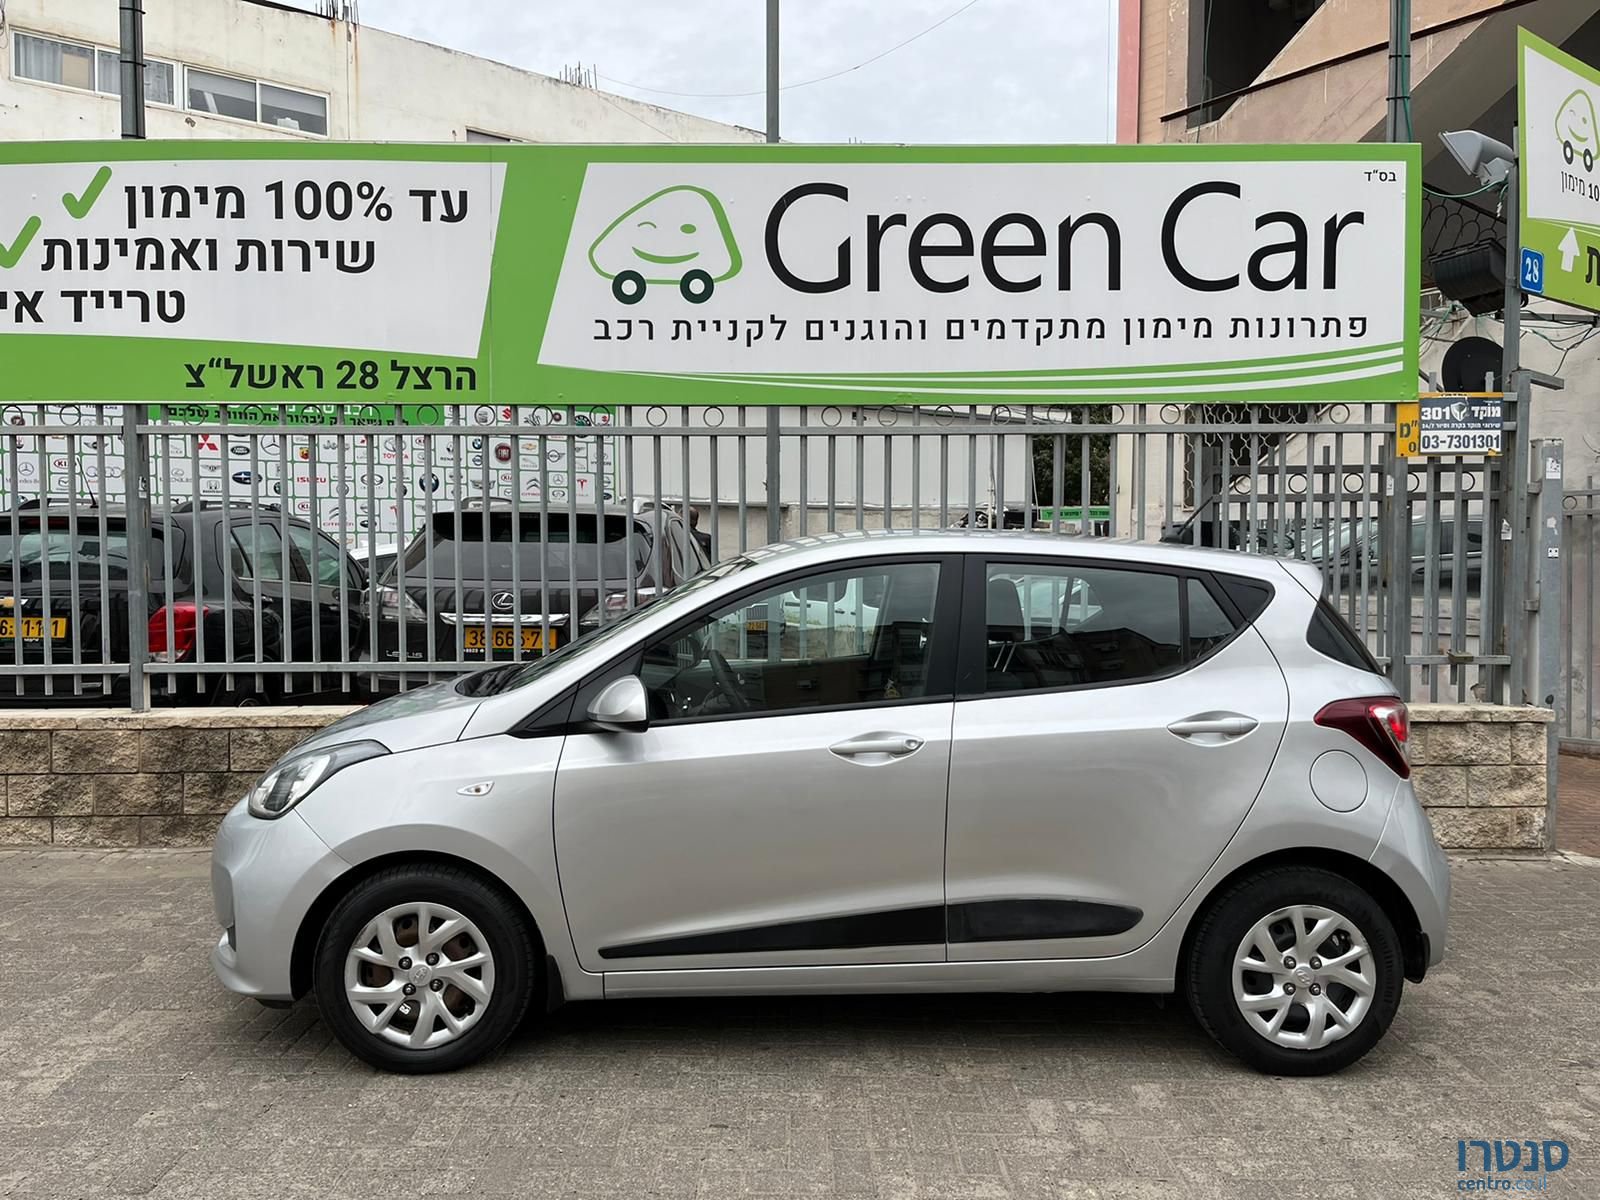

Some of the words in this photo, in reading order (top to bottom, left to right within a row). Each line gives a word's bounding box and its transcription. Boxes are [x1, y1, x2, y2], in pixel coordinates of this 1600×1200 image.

[1365, 171, 1397, 182] בס"ד
[125, 185, 246, 229] מימון
[266, 180, 393, 222] 100%
[409, 189, 468, 222] עד
[764, 182, 1121, 294] Green
[1162, 181, 1365, 292] Car
[41, 237, 218, 272] ואמינות
[235, 238, 375, 274] שירות
[1525, 257, 1539, 283] 28
[61, 290, 186, 323] טרייד
[593, 319, 654, 341] רכב
[671, 314, 787, 348] לקניית
[805, 319, 926, 341] והוגנים
[946, 318, 1105, 347] מתקדמים
[1124, 317, 1212, 346] מימון
[1230, 317, 1367, 339] פתרונות
[337, 360, 379, 390] 28
[391, 360, 476, 391] הרצל
[1421, 406, 1450, 420] 301
[1421, 434, 1500, 449] 03-7301301
